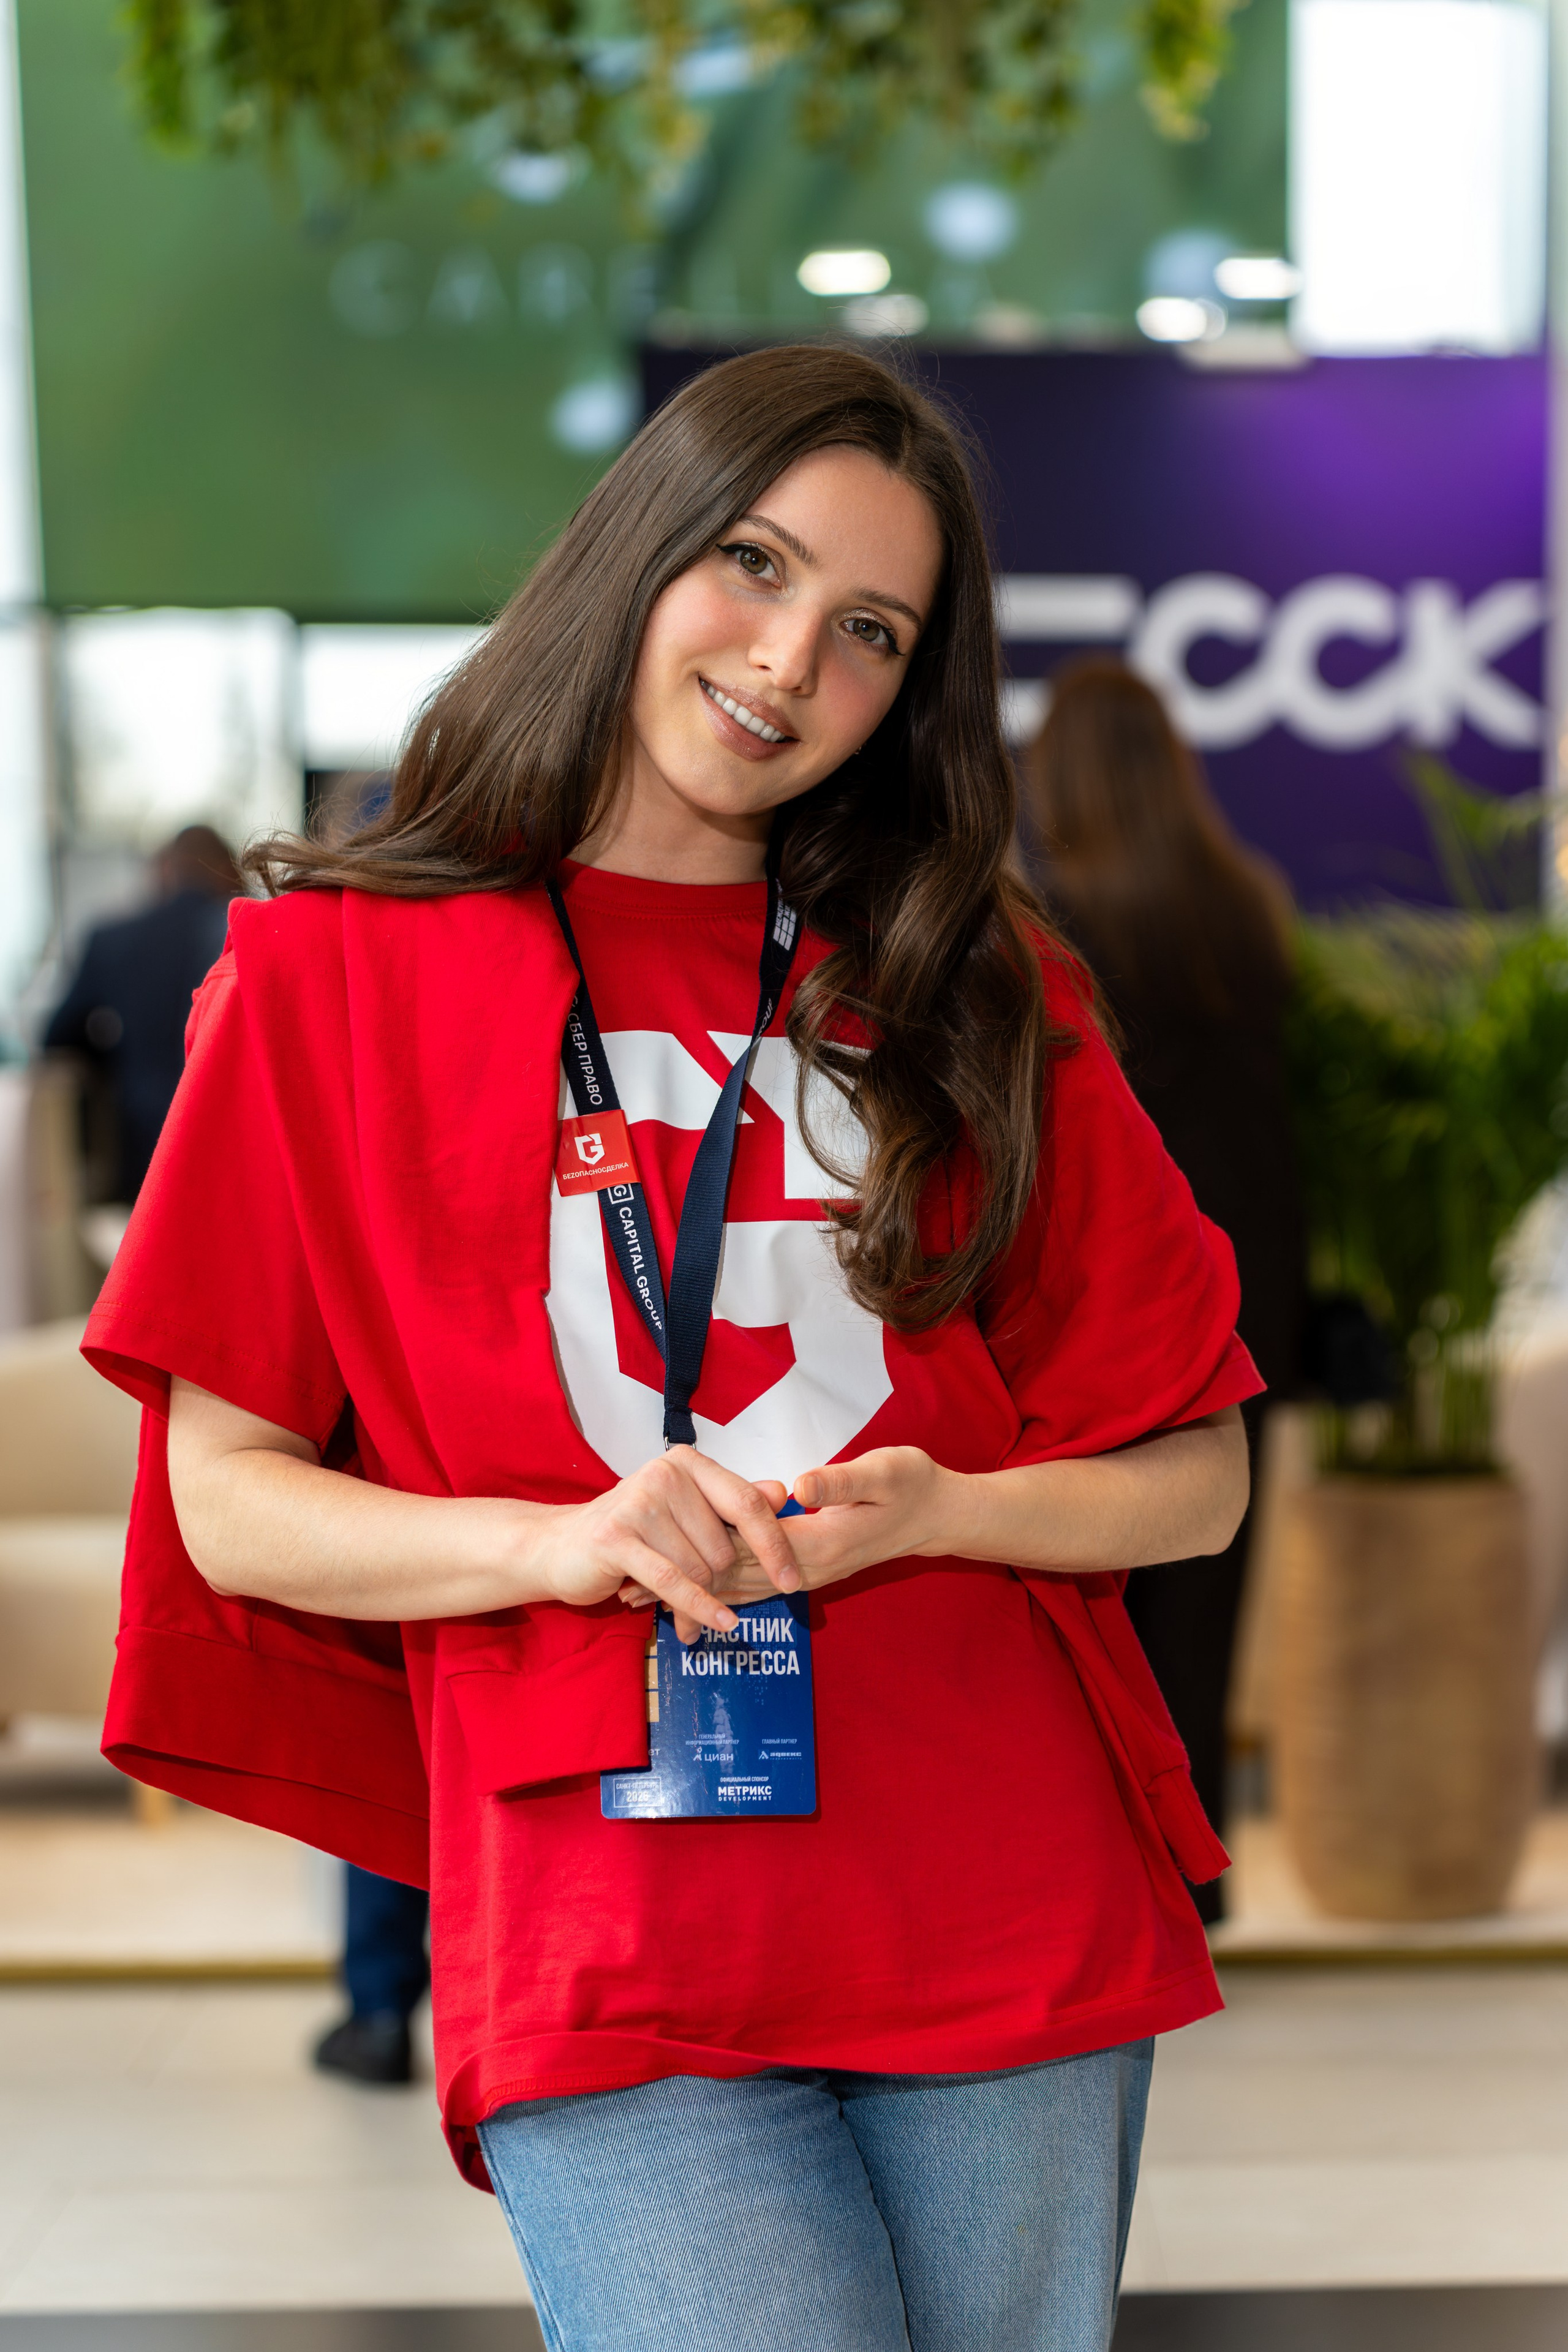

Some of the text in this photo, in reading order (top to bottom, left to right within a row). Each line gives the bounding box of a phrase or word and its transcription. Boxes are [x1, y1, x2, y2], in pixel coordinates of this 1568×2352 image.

[756, 997, 773, 1038] ROUP
[568, 1012, 603, 1105] СБЕР ПРАВО
[619, 1207, 644, 1274] CAPITAL
[637, 1275, 662, 1330] GROUP
[701, 1618, 794, 1643] ЧАСТНИК
[682, 1651, 800, 1676] КОНГРЕССА
[718, 1785, 772, 1796] МЕТРИКС
